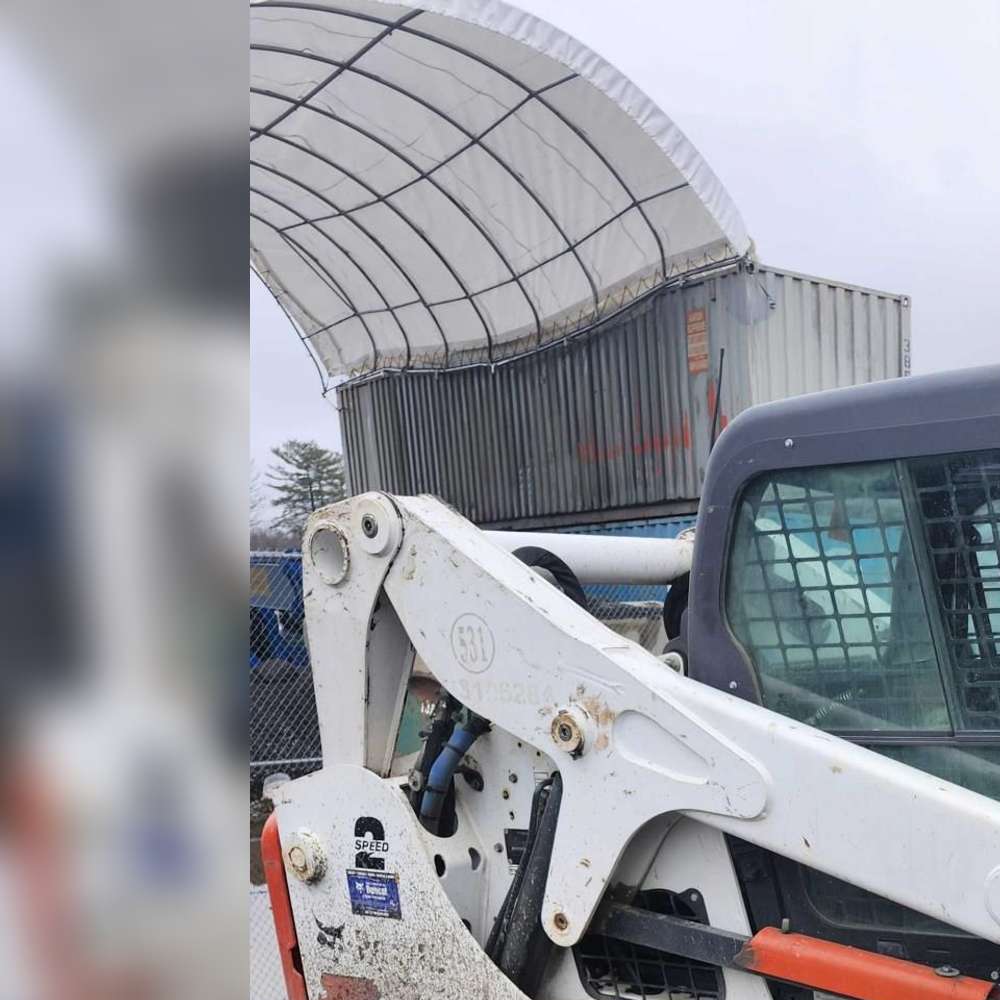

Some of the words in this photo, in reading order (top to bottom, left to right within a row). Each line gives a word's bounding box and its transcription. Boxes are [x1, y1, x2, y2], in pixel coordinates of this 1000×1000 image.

[457, 625, 488, 663] 531
[354, 816, 385, 870] 2
[354, 839, 389, 852] SPEED
